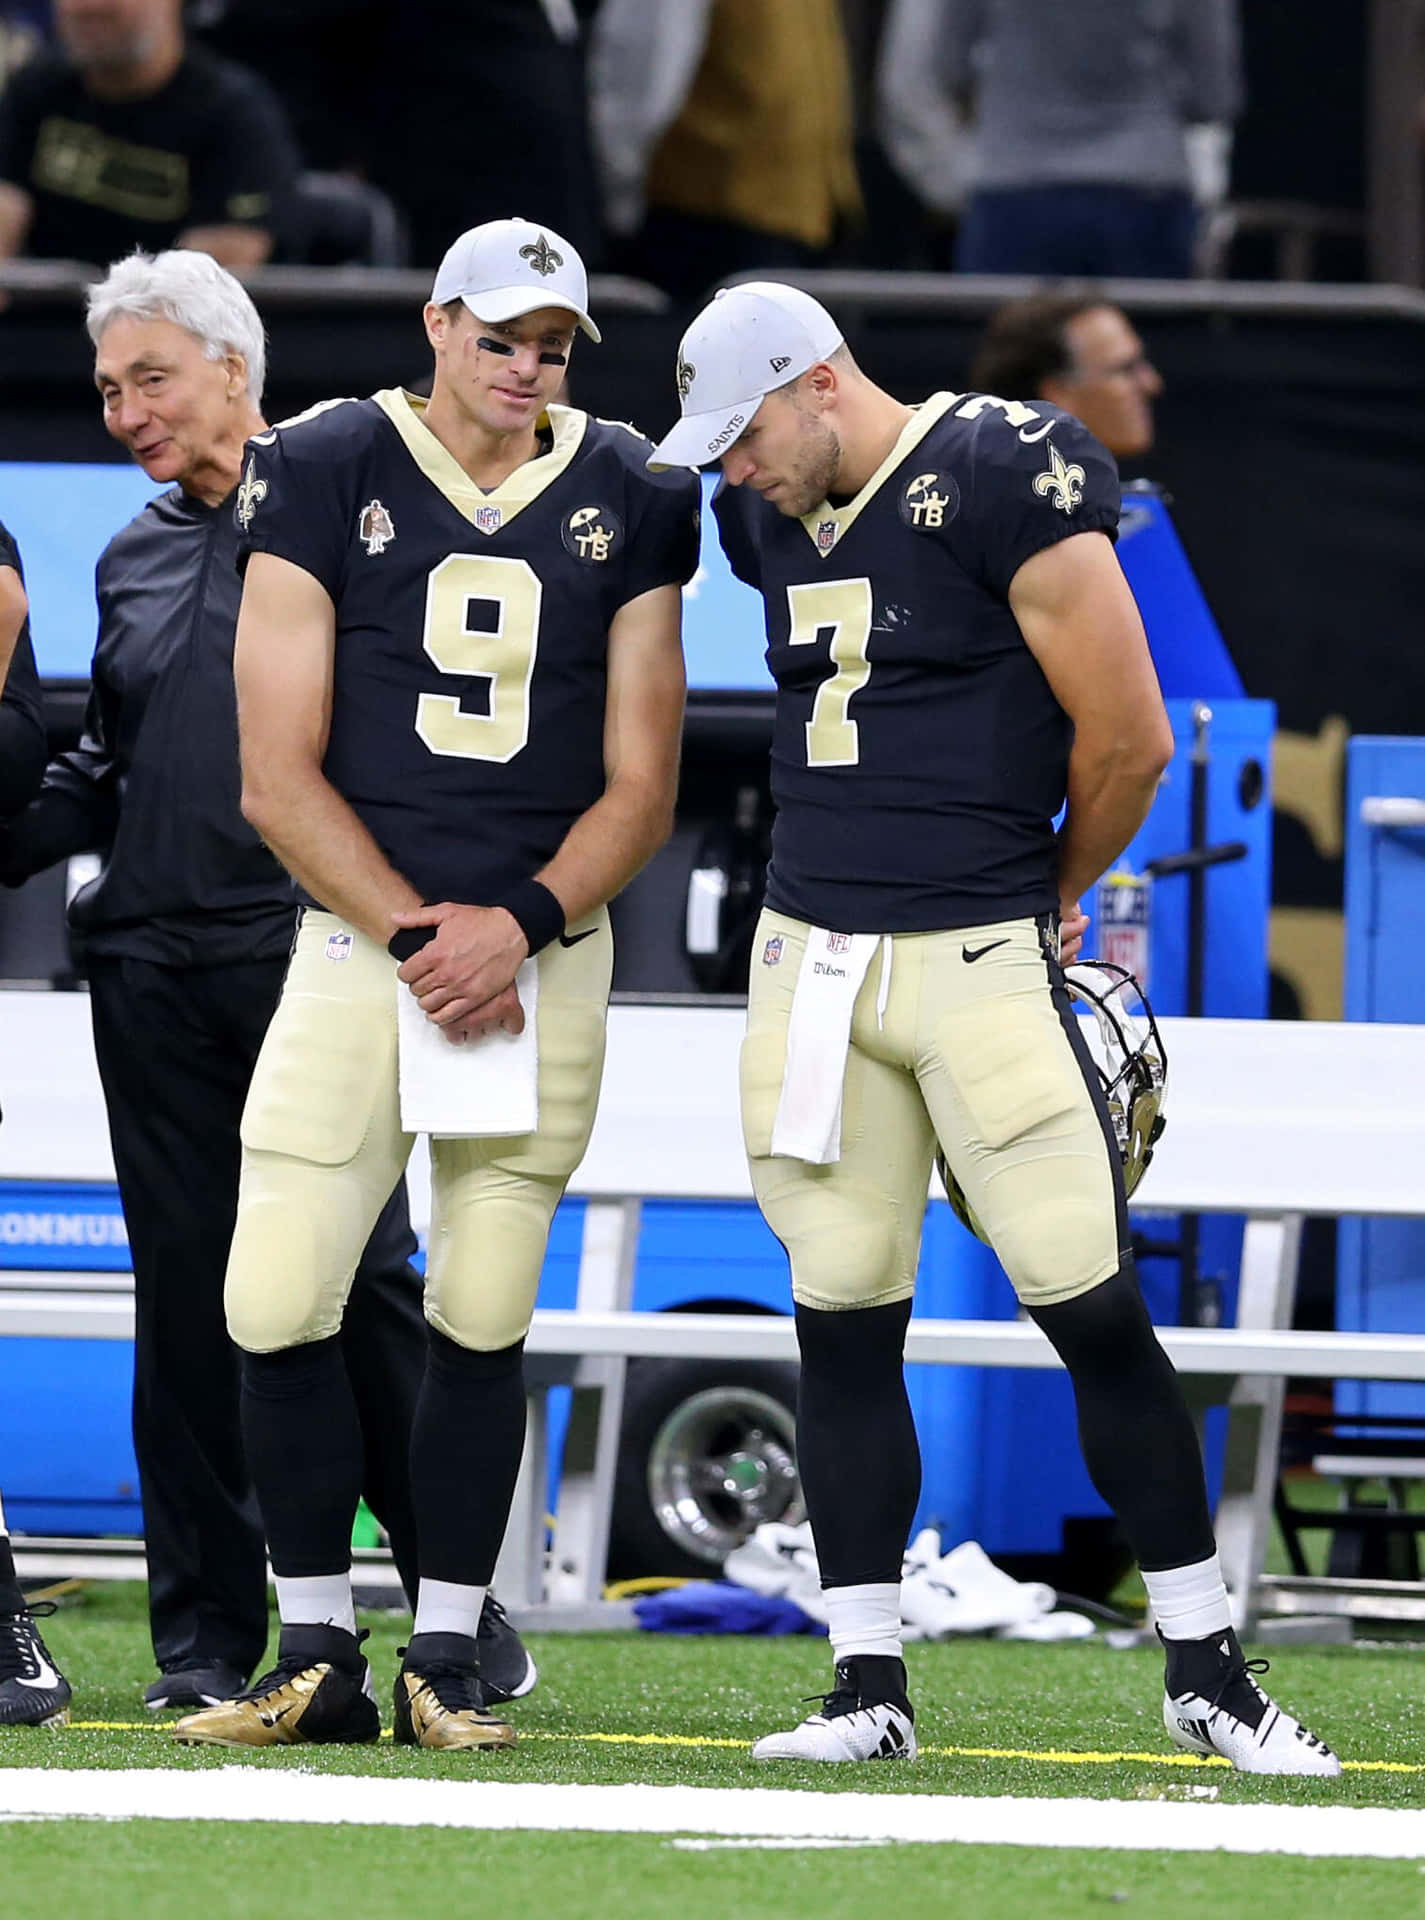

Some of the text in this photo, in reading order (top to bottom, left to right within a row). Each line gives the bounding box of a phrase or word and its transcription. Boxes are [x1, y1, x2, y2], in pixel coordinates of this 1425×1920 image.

[707, 414, 745, 453] SAINTS
[909, 501, 944, 528] TB
[575, 534, 609, 561] TB
[415, 553, 542, 764] 9
[787, 577, 872, 767] 7
[827, 933, 848, 951] NFL
[814, 961, 846, 977] Wilson
